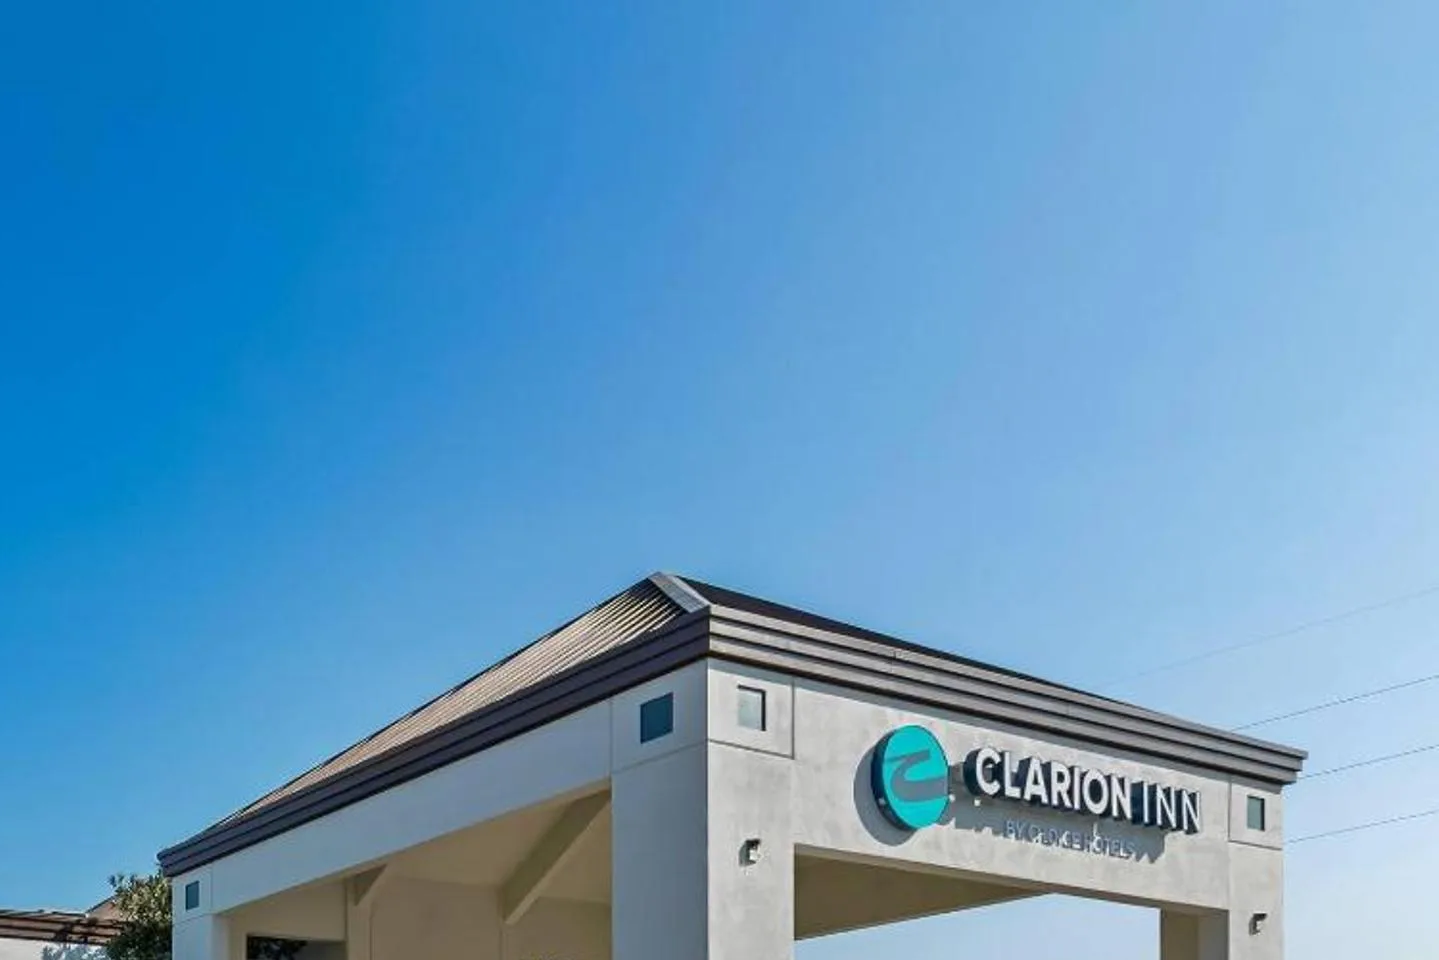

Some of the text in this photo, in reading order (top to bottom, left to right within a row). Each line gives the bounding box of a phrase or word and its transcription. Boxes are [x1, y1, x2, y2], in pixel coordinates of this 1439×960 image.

[974, 747, 1201, 834] CLARION INN
[1004, 820, 1025, 840] BY
